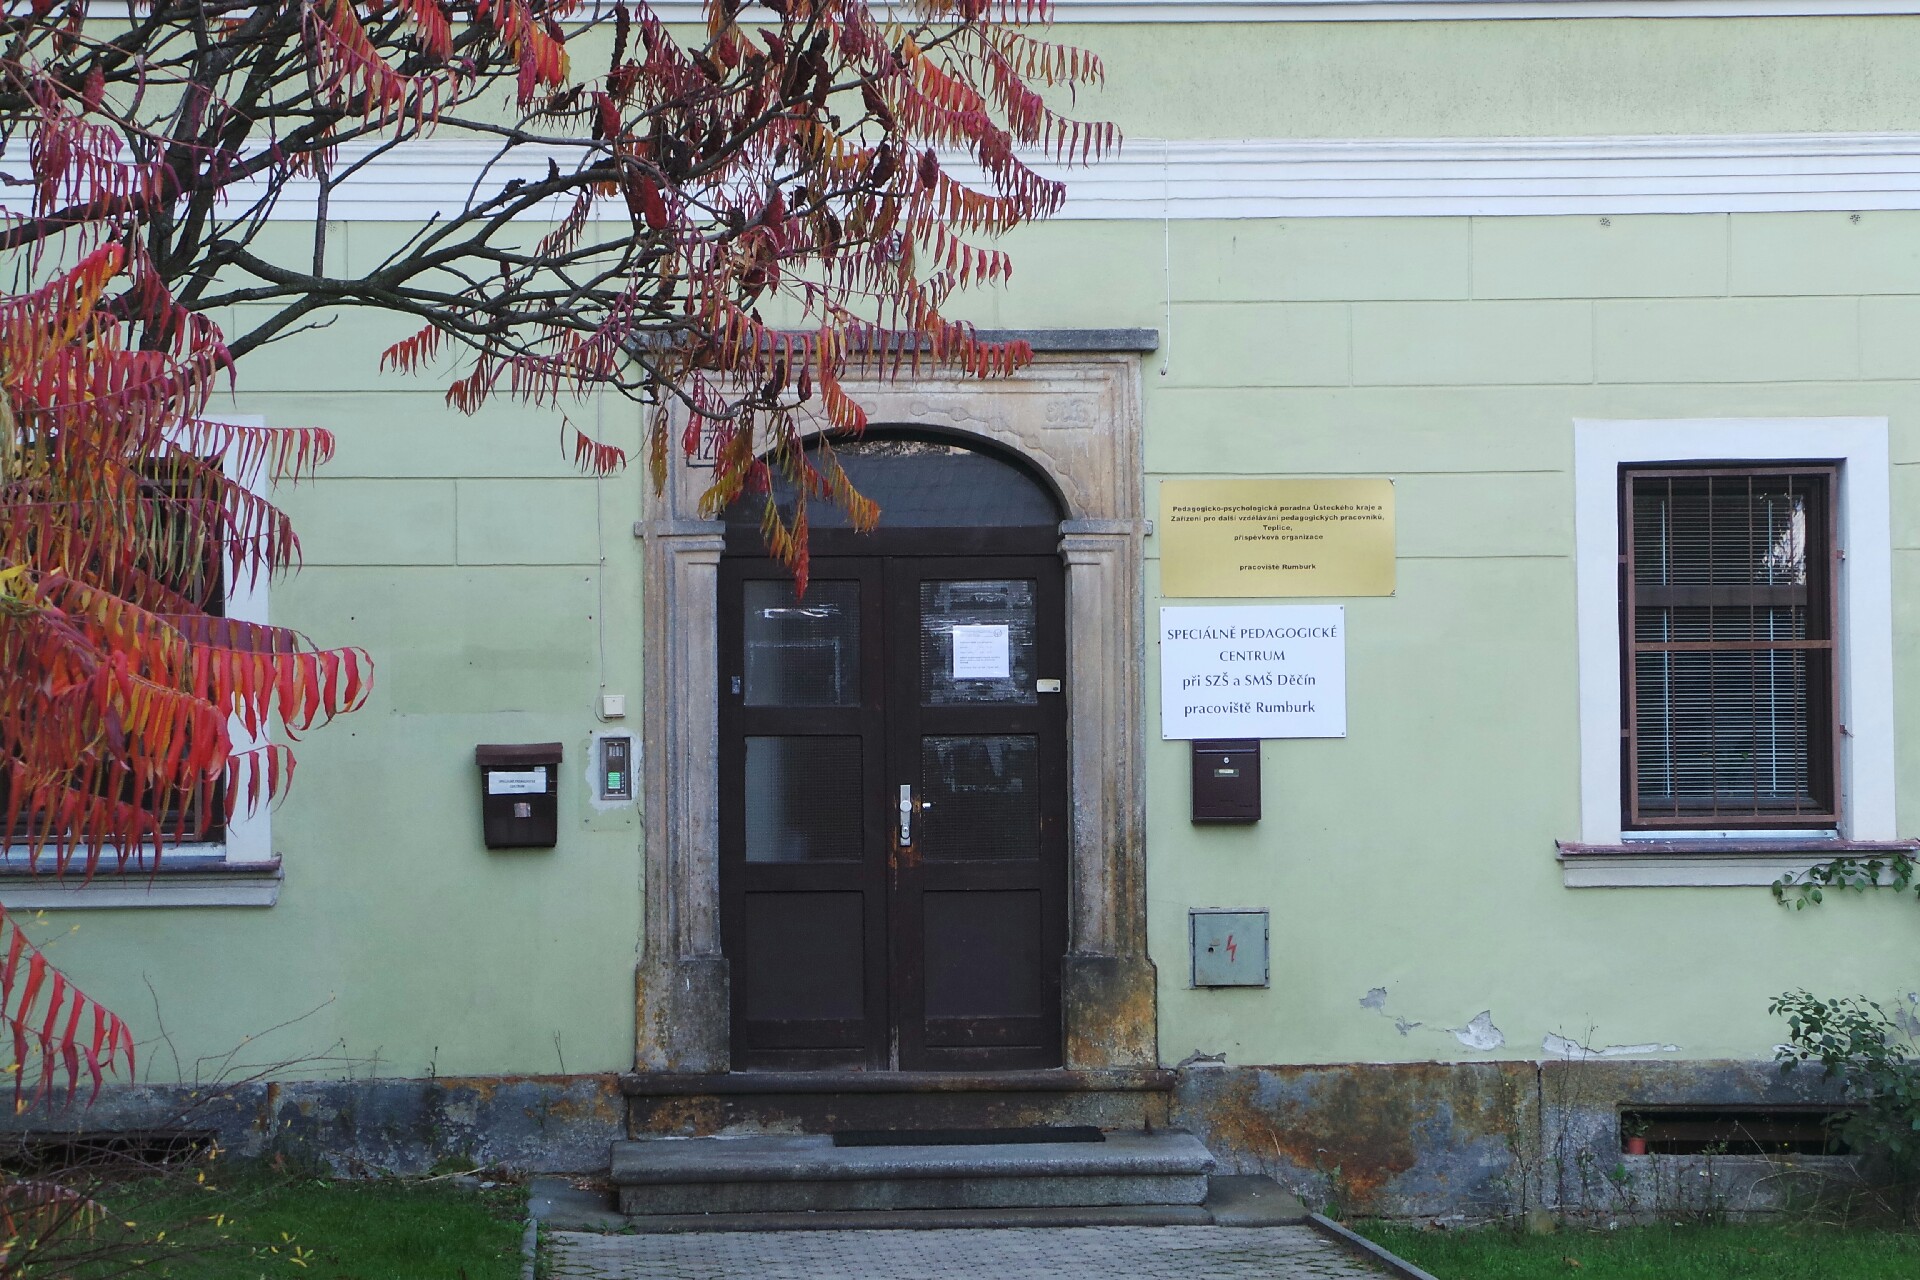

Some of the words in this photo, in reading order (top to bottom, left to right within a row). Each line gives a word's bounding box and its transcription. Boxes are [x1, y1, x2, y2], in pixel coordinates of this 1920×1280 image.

[1172, 504, 1278, 513] Pedagogicko-psychologická
[1279, 504, 1311, 513] poradna
[1356, 504, 1376, 513] kraje
[1203, 515, 1216, 523] pro
[1218, 514, 1237, 522] další
[1280, 514, 1338, 523] pedagogických
[1262, 524, 1293, 532] Teplice,
[1281, 534, 1324, 542] organizace
[1167, 626, 1236, 640] SPECIÁLNĚ
[1240, 625, 1338, 639] PEDAGOGICKÉ
[1219, 650, 1286, 662] CENTRUM
[1183, 674, 1201, 690] při
[1205, 672, 1229, 687] SZŠ
[1233, 677, 1241, 686] a
[1244, 671, 1273, 686] SMŠ
[1277, 673, 1316, 686] Děčín
[1184, 701, 1251, 718] pracoviště
[1256, 700, 1316, 713] Rumburk
